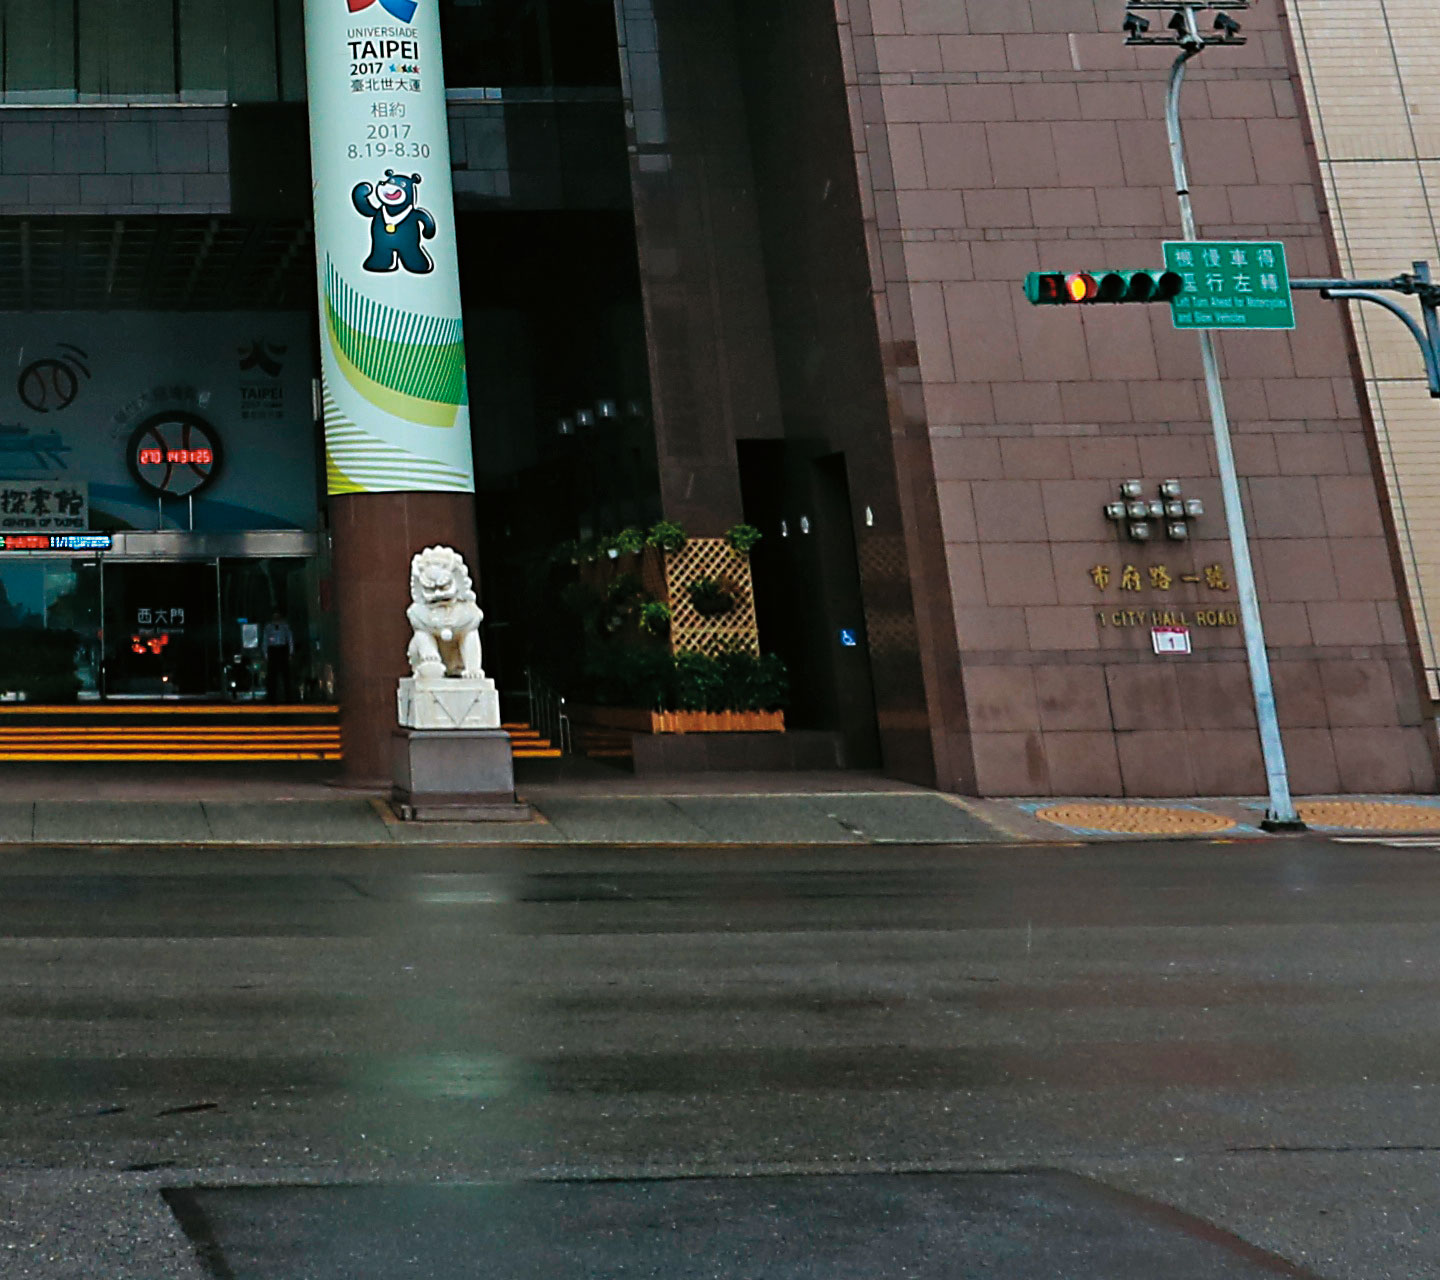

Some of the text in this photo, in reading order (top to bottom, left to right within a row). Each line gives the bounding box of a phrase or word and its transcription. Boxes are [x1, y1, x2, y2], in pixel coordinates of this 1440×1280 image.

[347, 27, 418, 38] UNIVERSIADE
[347, 40, 419, 60] TAIPEI
[350, 62, 383, 76] 2017
[350, 78, 421, 93] 臺北世大運
[371, 102, 405, 118] 相約
[367, 124, 411, 140] 2017
[348, 142, 430, 159] 8.19-8.30
[1175, 248, 1275, 268] 機慢車得
[240, 387, 283, 400] TAIPEI
[1090, 564, 1230, 591] 市府路一號
[138, 608, 184, 624] 西大門
[1112, 612, 1146, 626] CITY
[1152, 612, 1189, 626] HALL
[1196, 611, 1238, 626] ROAD
